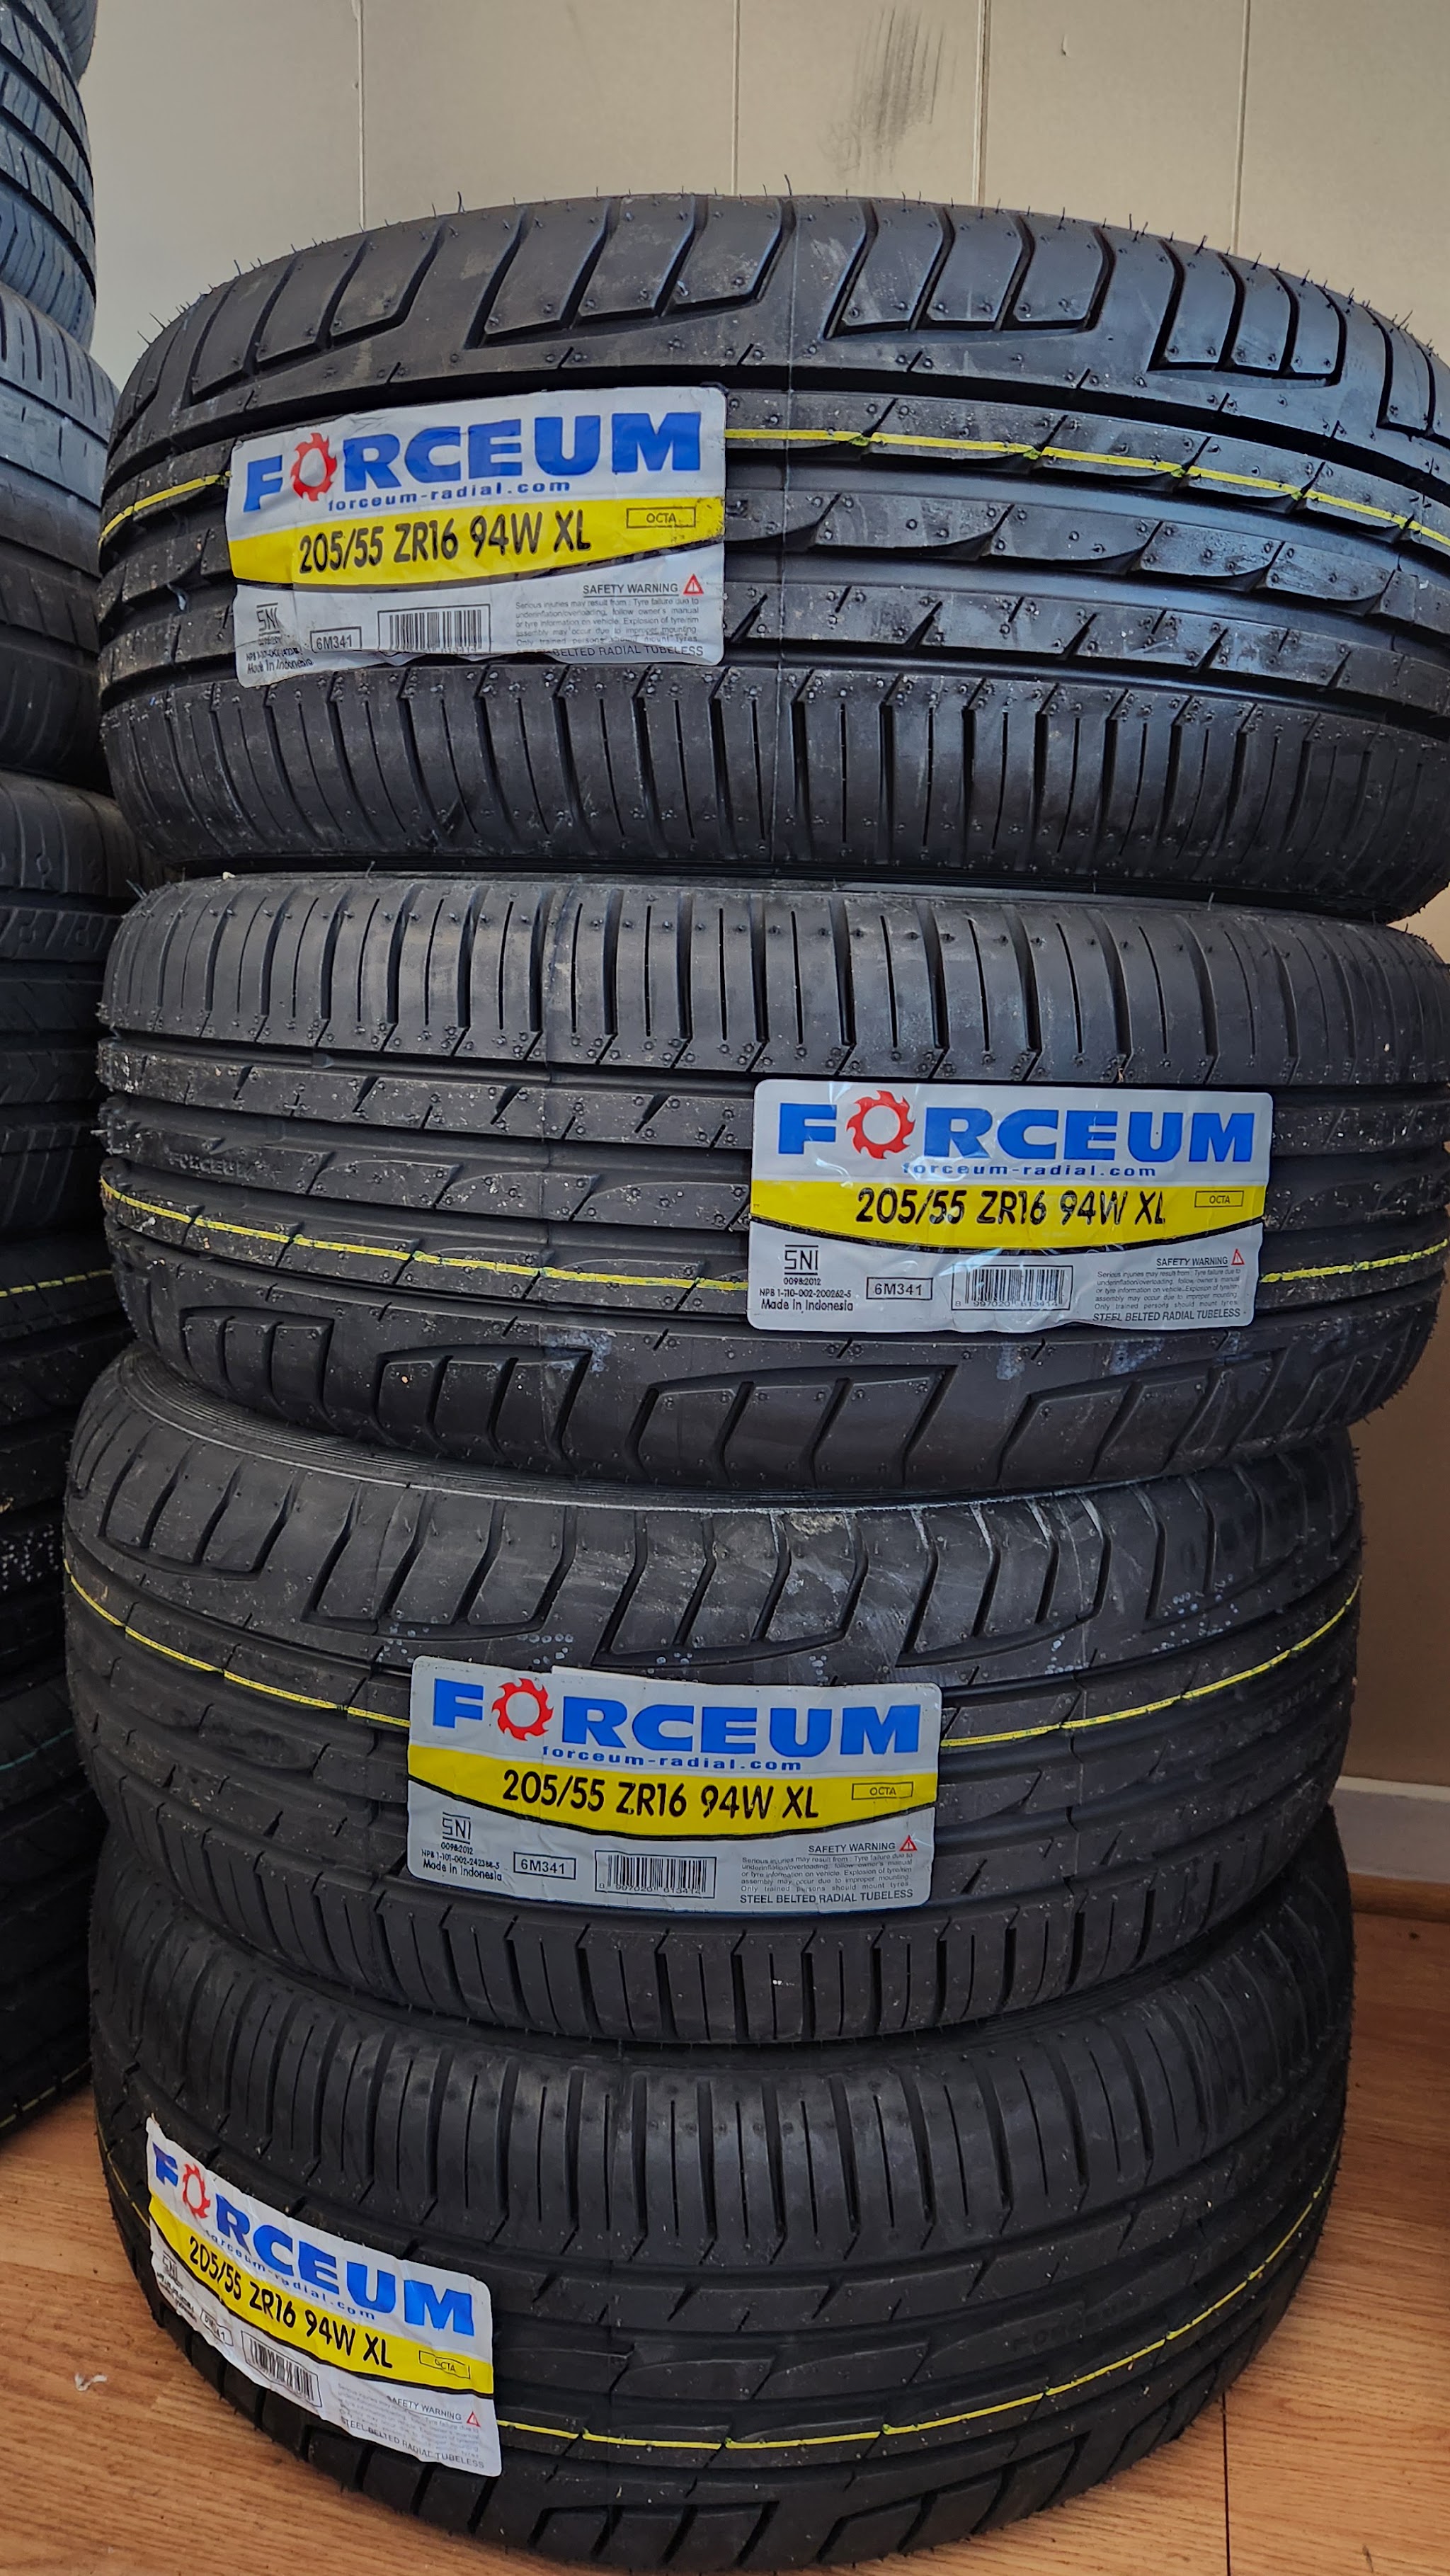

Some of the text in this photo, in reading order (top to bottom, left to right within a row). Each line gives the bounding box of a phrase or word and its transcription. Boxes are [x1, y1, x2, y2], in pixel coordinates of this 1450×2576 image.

[242, 411, 702, 513] FORCEUM
[328, 481, 571, 511] forceum-radial.com
[645, 513, 678, 525] OCTA
[299, 508, 592, 574] 205/55 ZR16 94W XL
[583, 583, 678, 594] SAFETY WARNING
[316, 634, 353, 651] 6M341
[599, 645, 641, 656] RADIAL
[644, 645, 704, 657] TUBELESS
[777, 1090, 1256, 1163] FORCEUM
[903, 1162, 1156, 1177] forceum-radial.com
[855, 1187, 1166, 1226] 205/55 ZR16 94W XL
[1209, 1195, 1231, 1204] OCTA
[784, 1249, 818, 1270] SNI
[1156, 1256, 1228, 1267] SAFETY WARNING
[759, 1288, 775, 1297] NPB
[874, 1283, 923, 1296] 6M341
[761, 1298, 789, 1310] Made
[806, 1299, 854, 1311] Indonesia
[1092, 1308, 1241, 1322] STEEL BELTED RADIAL TUBELESS
[433, 1677, 921, 1758] FORCEUM
[542, 1745, 801, 1772] forceum-radial.com
[502, 1769, 820, 1820] 205/55 ZR16 94W XL
[869, 1786, 897, 1796] OCTA
[442, 1816, 472, 1840] SNI
[808, 1842, 896, 1853] SAFETY WARNING
[423, 1858, 447, 1872] Made
[460, 1865, 503, 1881] Indonesia
[520, 1858, 566, 1875] 6M341
[740, 1888, 914, 1904] STEEL BELTED RADIAL TUBELESS
[152, 2141, 475, 2336] FORCEUM
[189, 2235, 242, 2301] 205/55
[249, 2280, 297, 2328] ZR16
[304, 2309, 357, 2356] 94W
[362, 2332, 393, 2369] XL
[433, 2358, 457, 2373] OCTA
[421, 2404, 462, 2420] WARNING
[435, 2452, 486, 2469] TUBELESS
